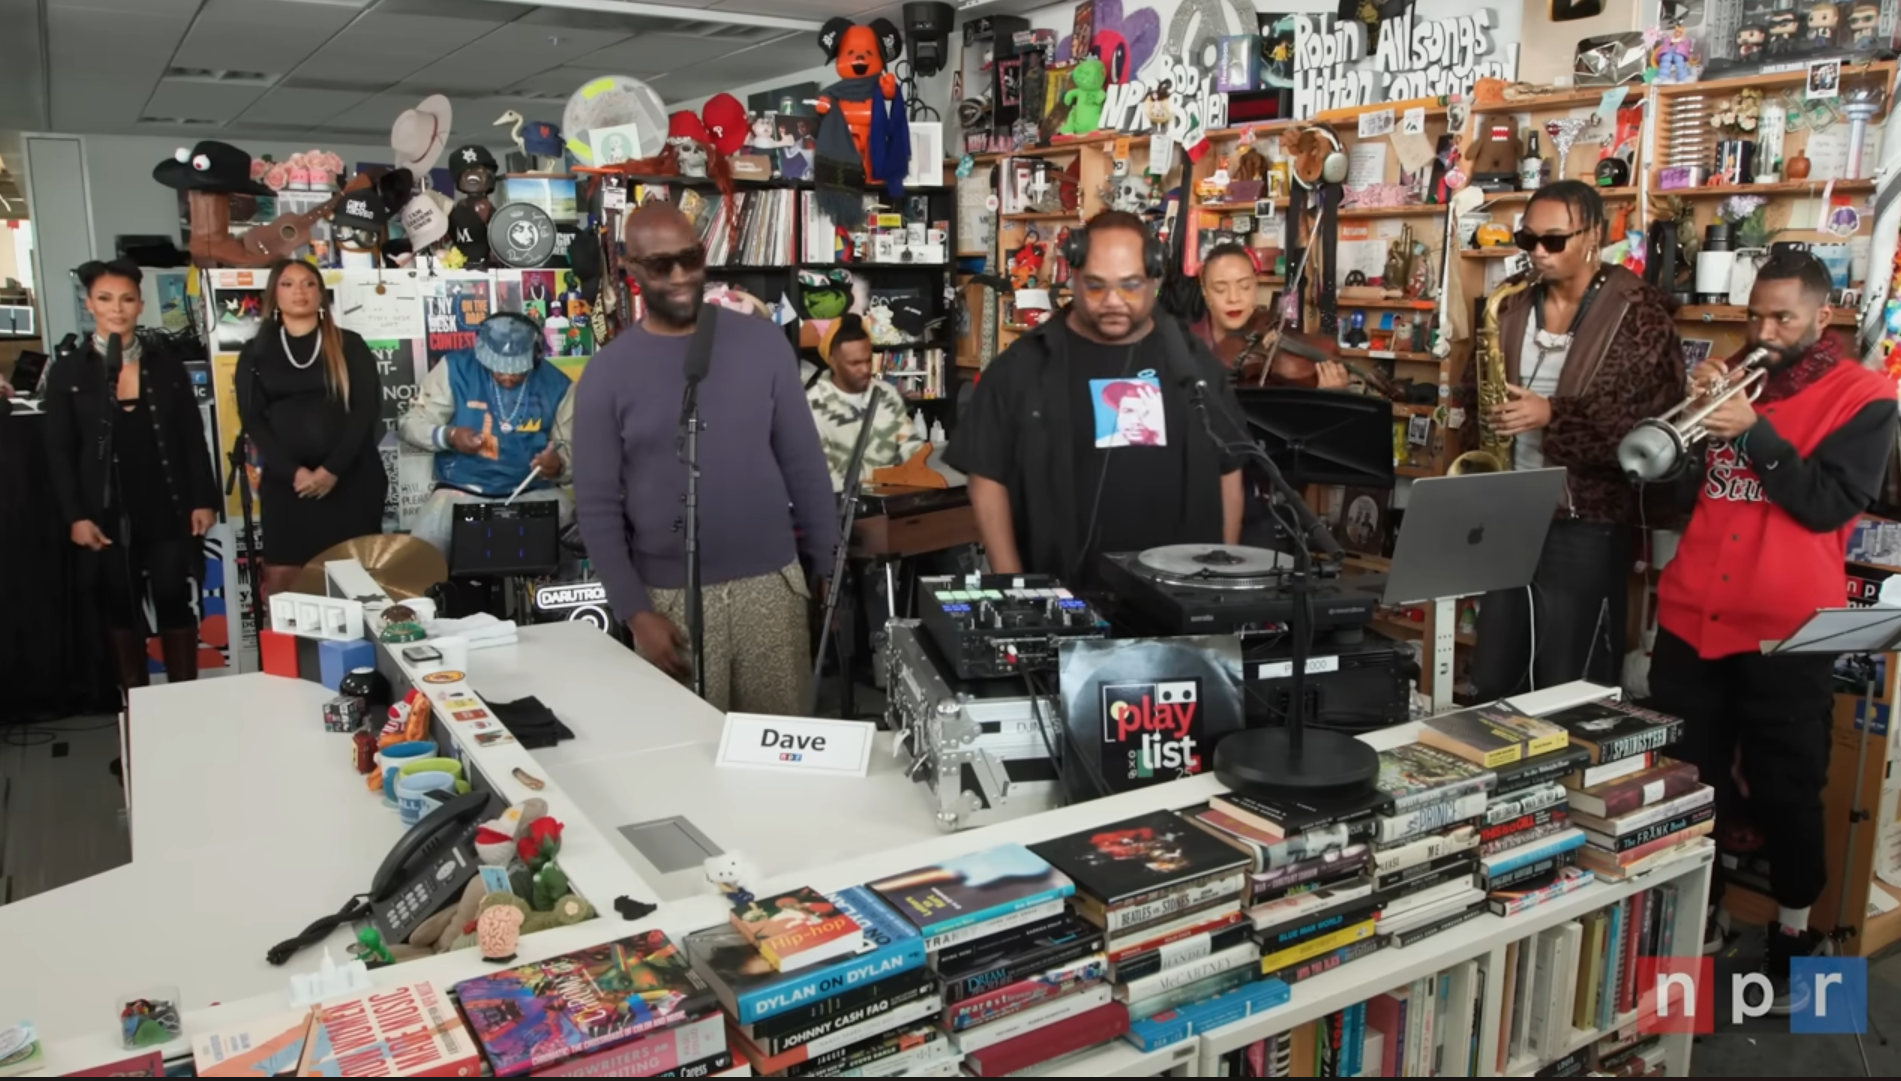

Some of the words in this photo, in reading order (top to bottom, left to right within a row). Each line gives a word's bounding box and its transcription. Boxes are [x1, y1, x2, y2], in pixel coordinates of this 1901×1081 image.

[1294, 13, 1360, 71] Robin
[1376, 3, 1490, 78] Allsongs
[1160, 47, 1200, 96] Bob
[1293, 62, 1373, 121] Hilton
[456, 227, 473, 243] M
[428, 314, 458, 332] DESK
[429, 331, 477, 350] CONTEST
[1847, 579, 1876, 600] np
[1117, 694, 1197, 742] play
[760, 728, 827, 752] Dave
[1141, 733, 1198, 770] list
[1612, 726, 1668, 761] SPRINGSTEEN
[1637, 826, 1669, 845] FRANK
[1121, 906, 1153, 926] BEATLES
[1162, 893, 1190, 914] STONES
[769, 915, 846, 951] Hip-hop
[1278, 930, 1298, 943] BLUE
[1318, 915, 1343, 930] WORLD
[755, 984, 817, 1015] DYLAN
[819, 975, 844, 993] ON
[846, 954, 904, 984] DYLAN
[967, 968, 1007, 993] DREAM
[1159, 956, 1232, 990] McCARTNEY
[782, 1021, 833, 1050] JOHNNY
[834, 1009, 864, 1029] CASH
[866, 1000, 889, 1016] FAQ
[560, 1046, 650, 1077] NGWRITERS
[600, 1057, 660, 1077] RITING
